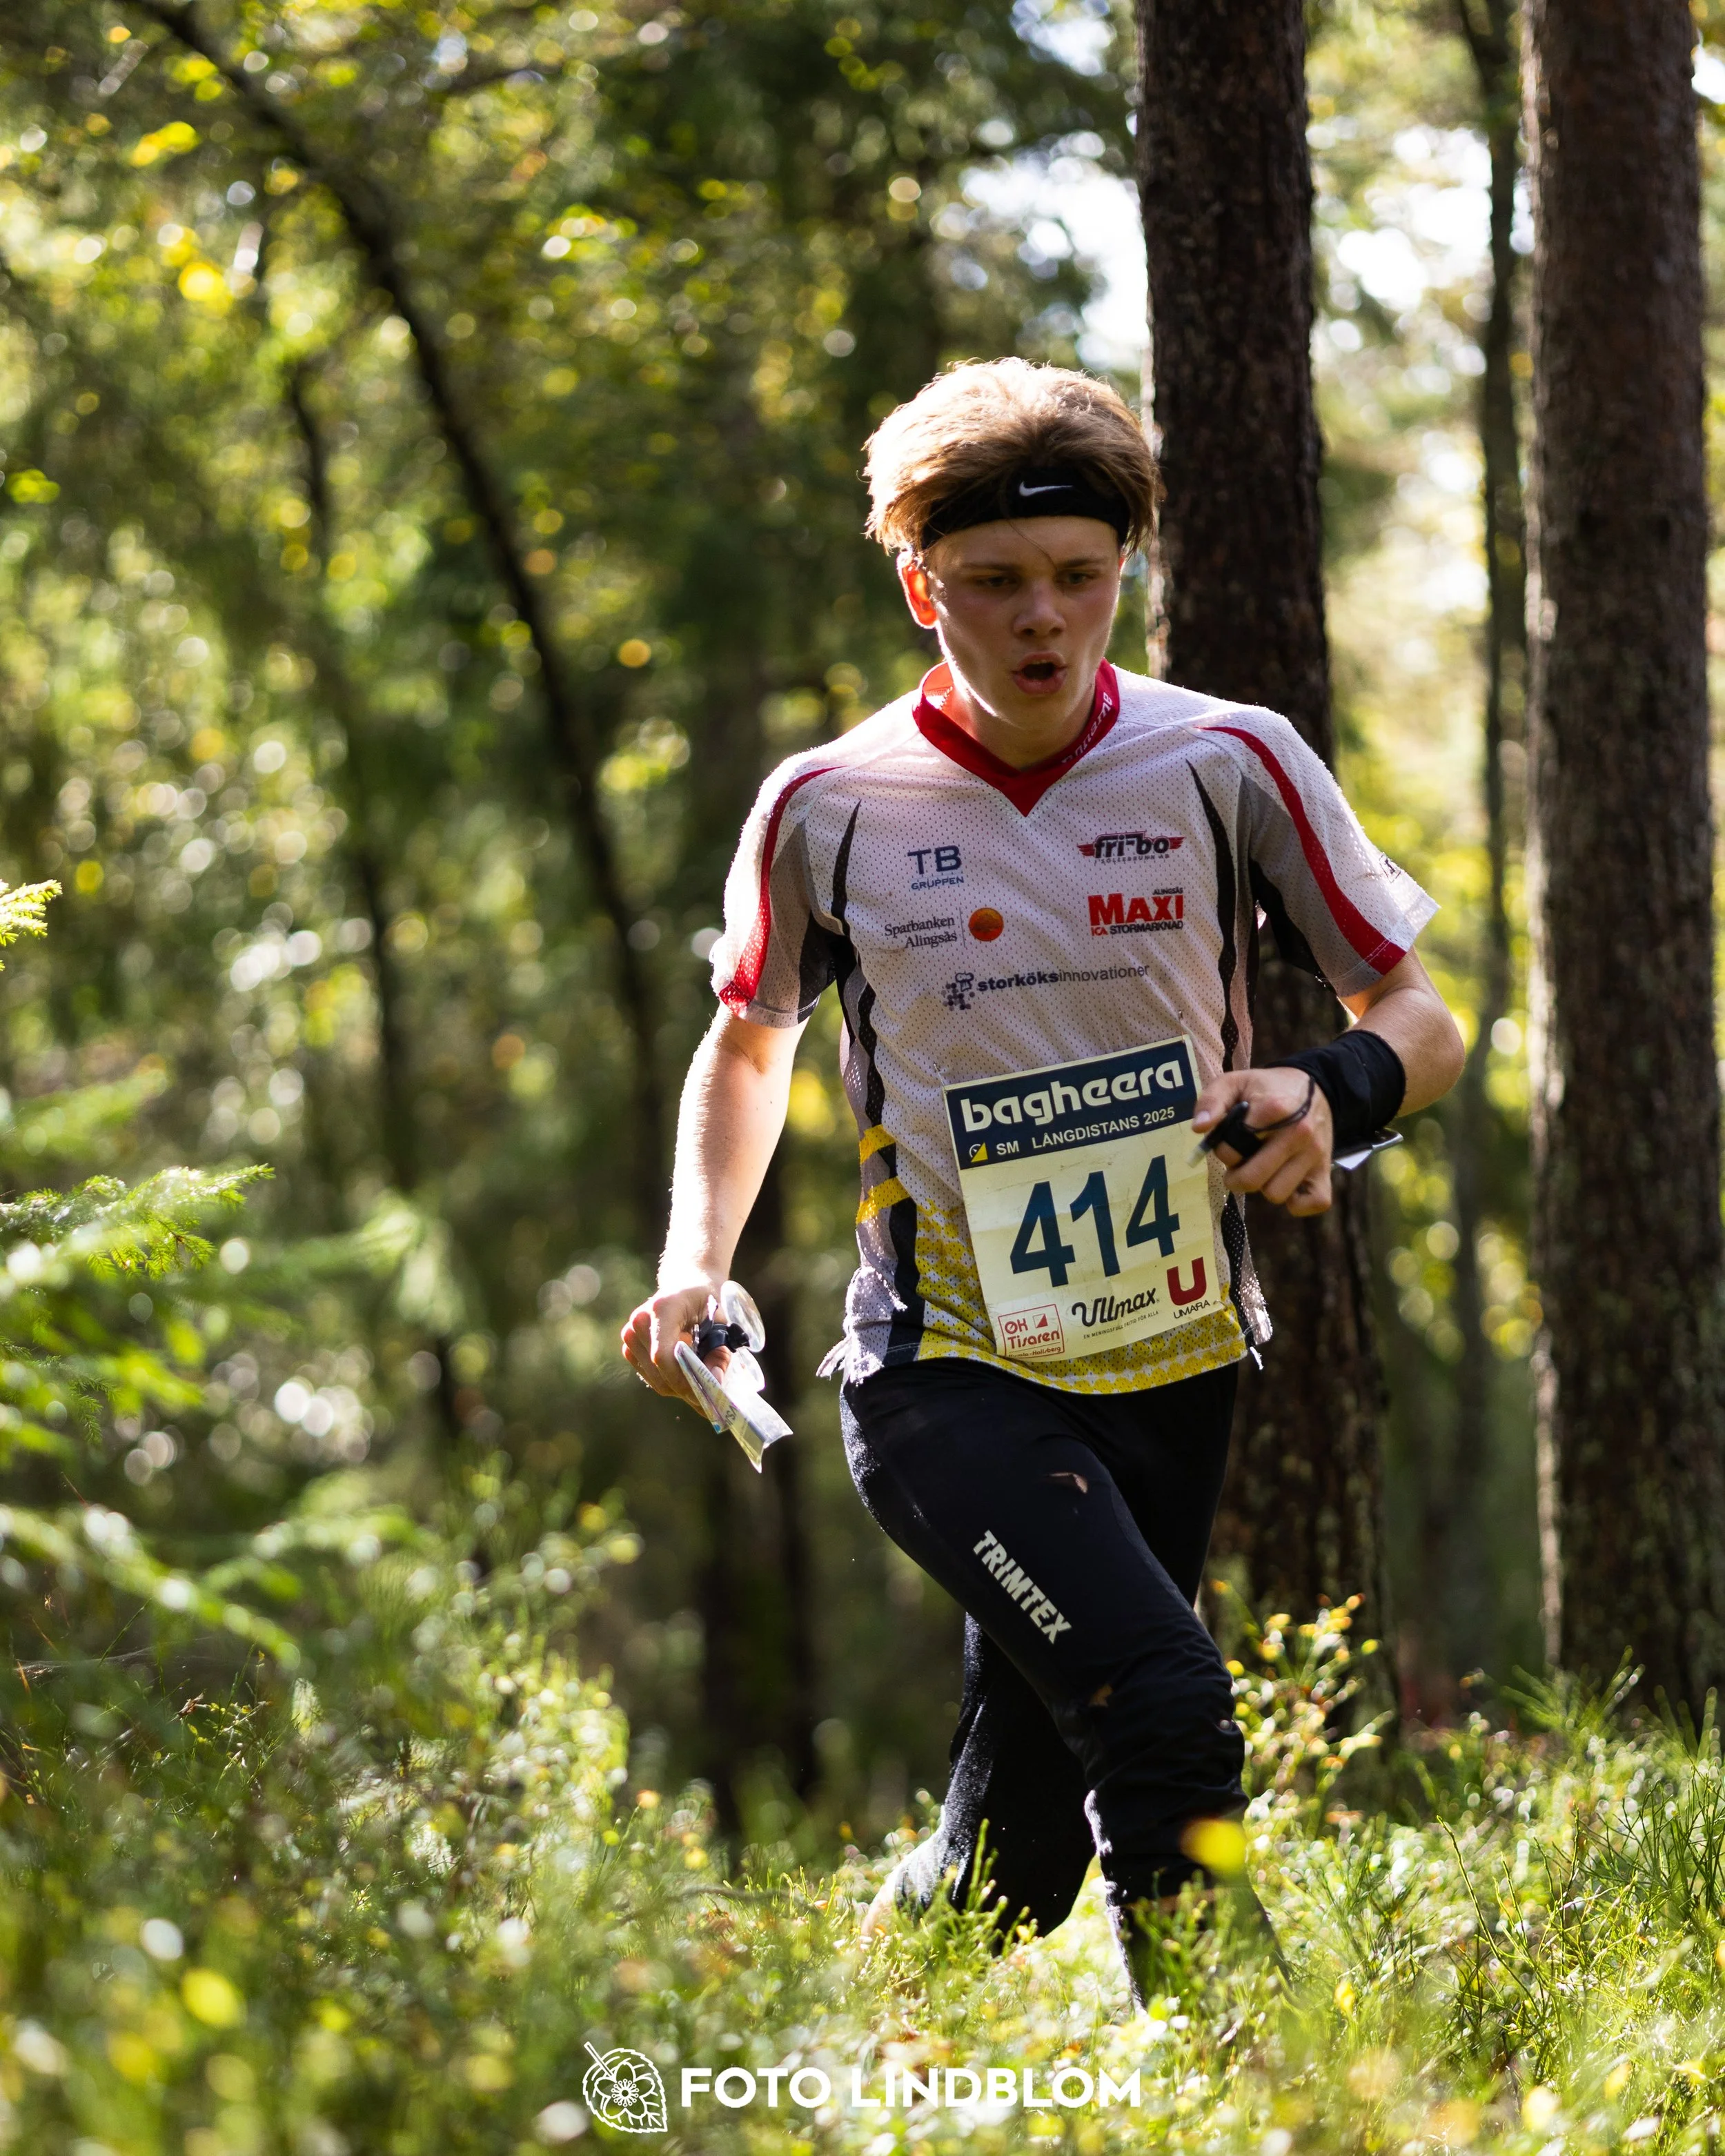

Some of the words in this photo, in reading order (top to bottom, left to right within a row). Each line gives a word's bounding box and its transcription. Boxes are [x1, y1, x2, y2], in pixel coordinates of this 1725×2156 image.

[1094, 832, 1171, 858] fri-bo
[907, 845, 962, 875] TB
[911, 876, 965, 890] GRUPPEN
[884, 916, 955, 938] Sparbanken
[905, 931, 958, 949] Alingsås
[1091, 926, 1108, 936] ICA
[1110, 920, 1183, 935] STORMARKNAD
[977, 965, 1150, 991] storköksinnovationer
[960, 1059, 1184, 1132] bagheera
[996, 1140, 1020, 1156] SM
[1032, 1111, 1140, 1149] LÅNGDISTANS
[1143, 1107, 1175, 1125] 2025
[1009, 1154, 1181, 1287] 414
[1166, 1256, 1207, 1306] U
[1071, 1287, 1156, 1327] Ullmax
[1173, 1300, 1211, 1319] UMARA
[1007, 1330, 1060, 1349] Tisaren
[1092, 1325, 1124, 1337] MENINGSFULL
[1124, 1319, 1137, 1327] FRITID
[973, 1530, 1072, 1644] TRIMTEX
